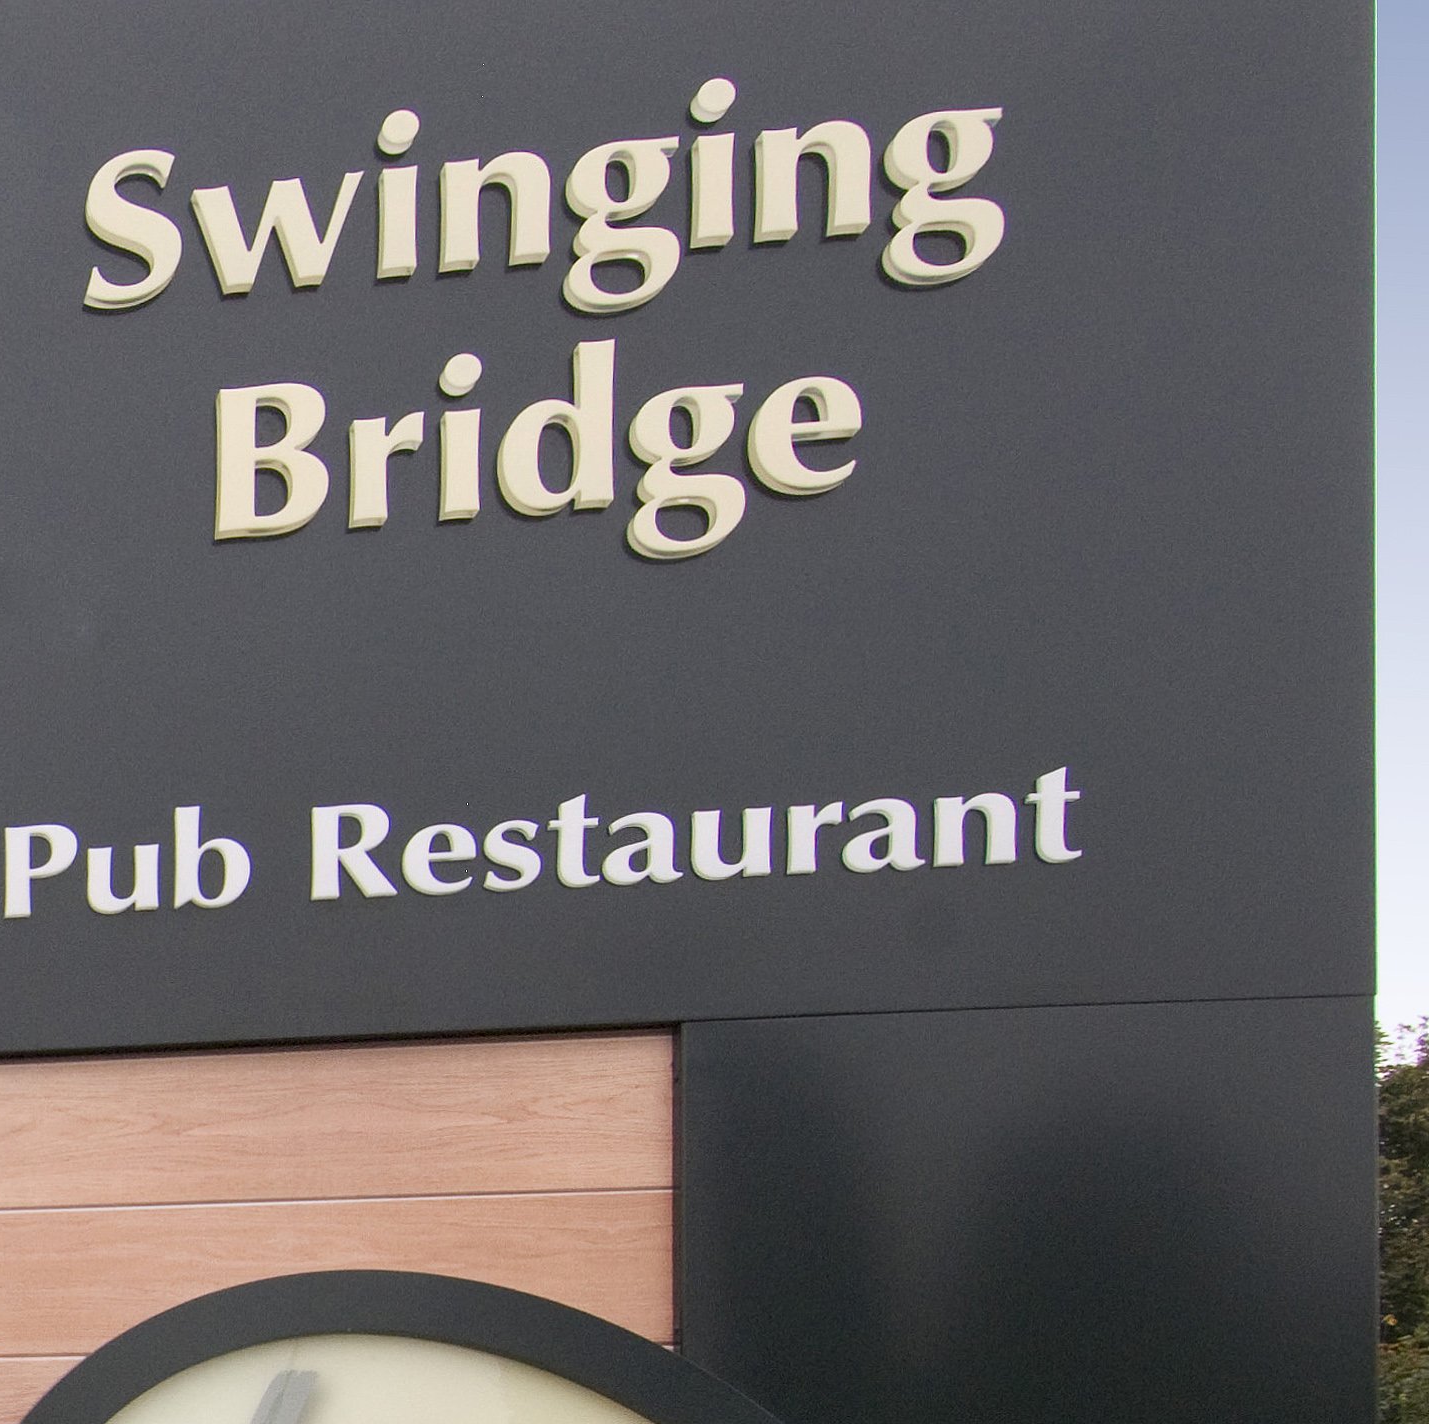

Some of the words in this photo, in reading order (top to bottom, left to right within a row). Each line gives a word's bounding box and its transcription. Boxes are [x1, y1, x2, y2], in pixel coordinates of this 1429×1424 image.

[83, 77, 1006, 313] Swinging
[213, 338, 862, 561] Bridge
[3, 804, 252, 919] Pub
[309, 765, 1083, 903] Restaurant
